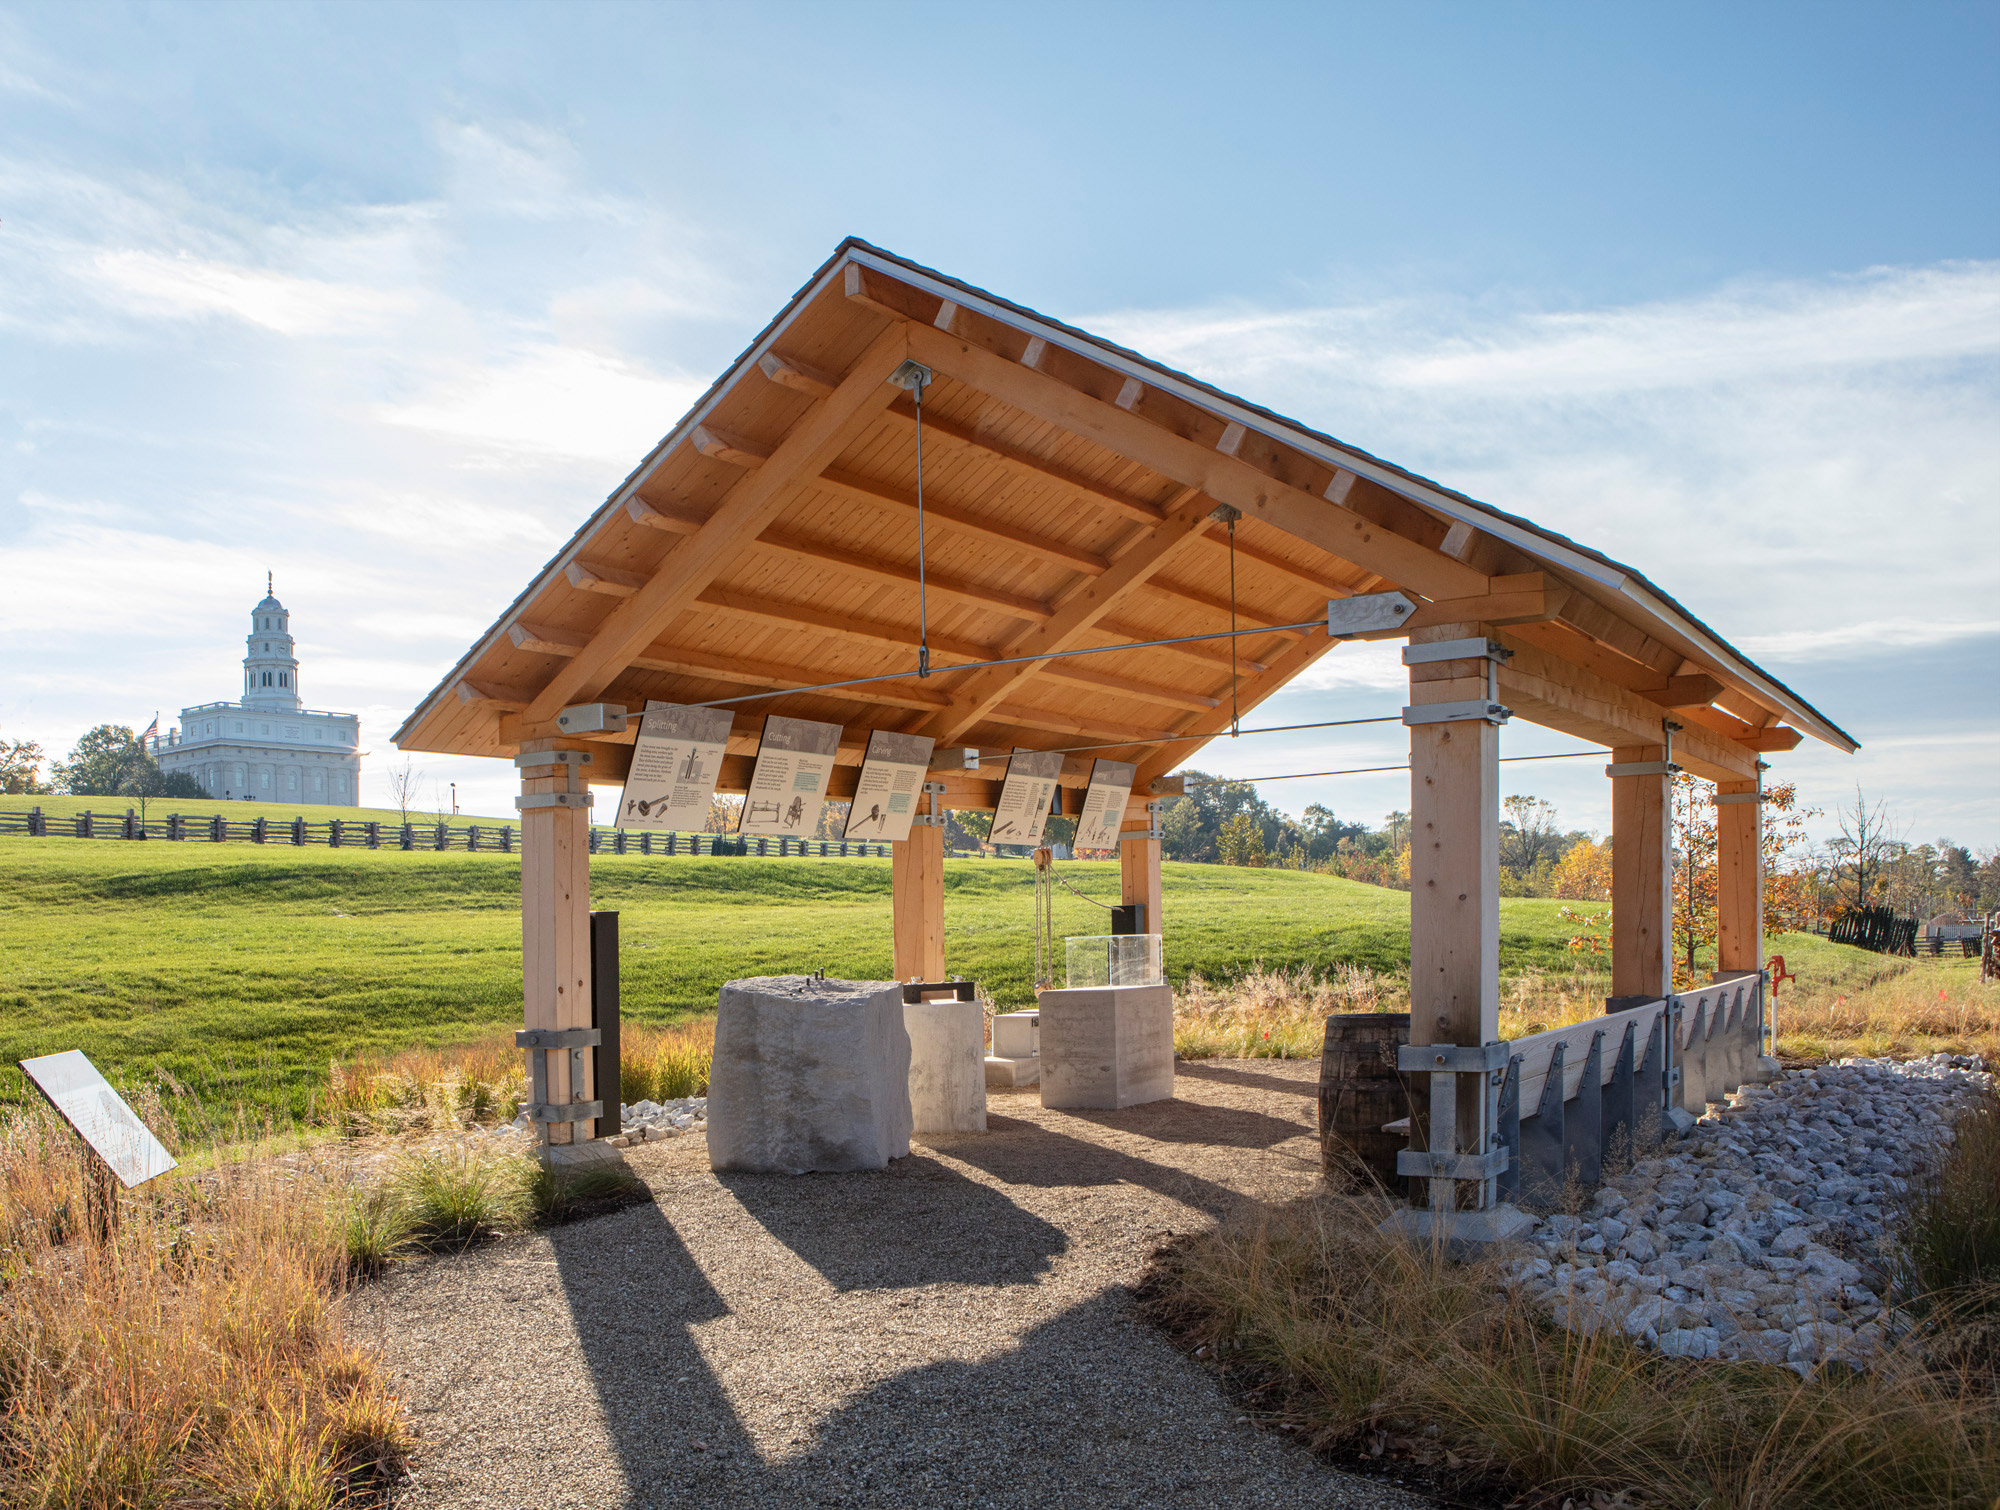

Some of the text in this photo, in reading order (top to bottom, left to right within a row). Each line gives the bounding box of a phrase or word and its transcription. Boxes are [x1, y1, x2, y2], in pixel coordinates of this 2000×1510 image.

[648, 719, 677, 733] Splitting
[768, 731, 792, 744] Cutting
[872, 745, 892, 757] Carving
